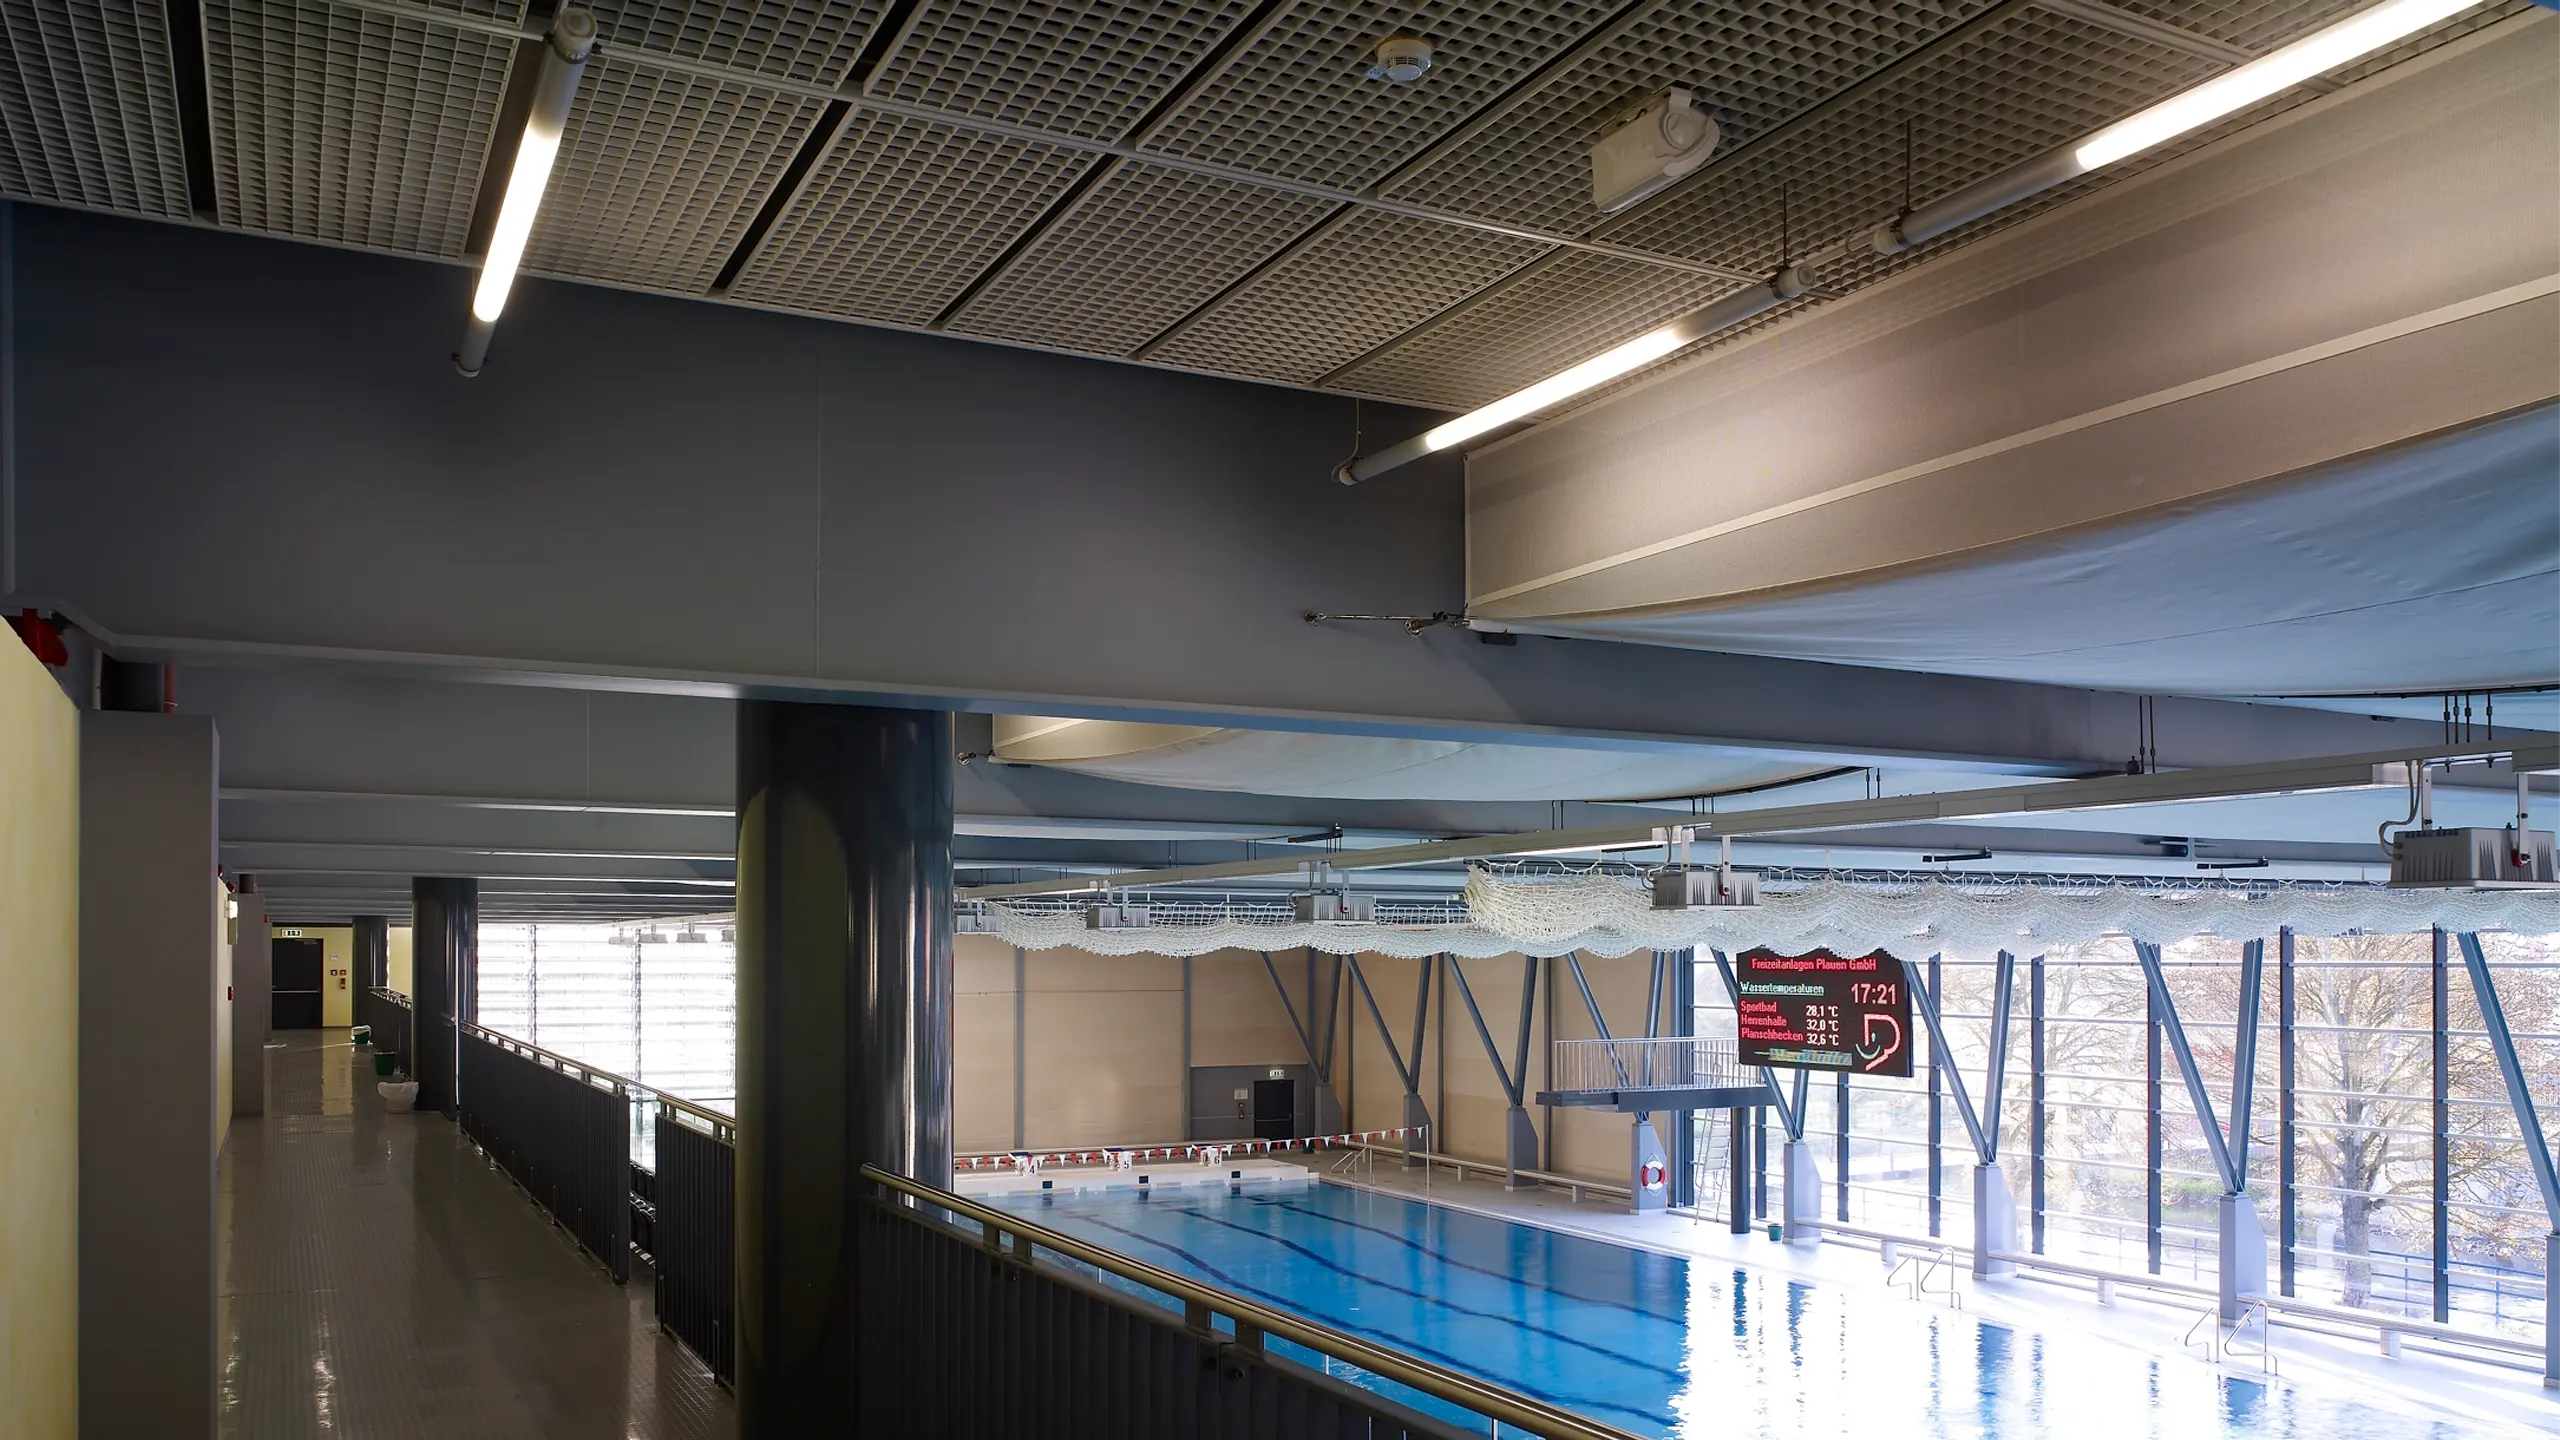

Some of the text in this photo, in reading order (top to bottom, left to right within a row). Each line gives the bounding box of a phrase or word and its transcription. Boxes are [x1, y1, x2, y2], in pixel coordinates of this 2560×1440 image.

[1751, 958, 1877, 972] Freizeitanlagen Plauen GmbH
[1740, 981, 1824, 995] Wassertemperaturen
[1851, 983, 1897, 1005] 17:21
[1741, 1001, 1839, 1018] Sportbad 28,1 °C
[1741, 1014, 1839, 1032] Herrenhalle 32,0 °C
[1741, 1028, 1839, 1046] Planschbecken 32,6 °C
[1124, 1160, 1129, 1170] 5
